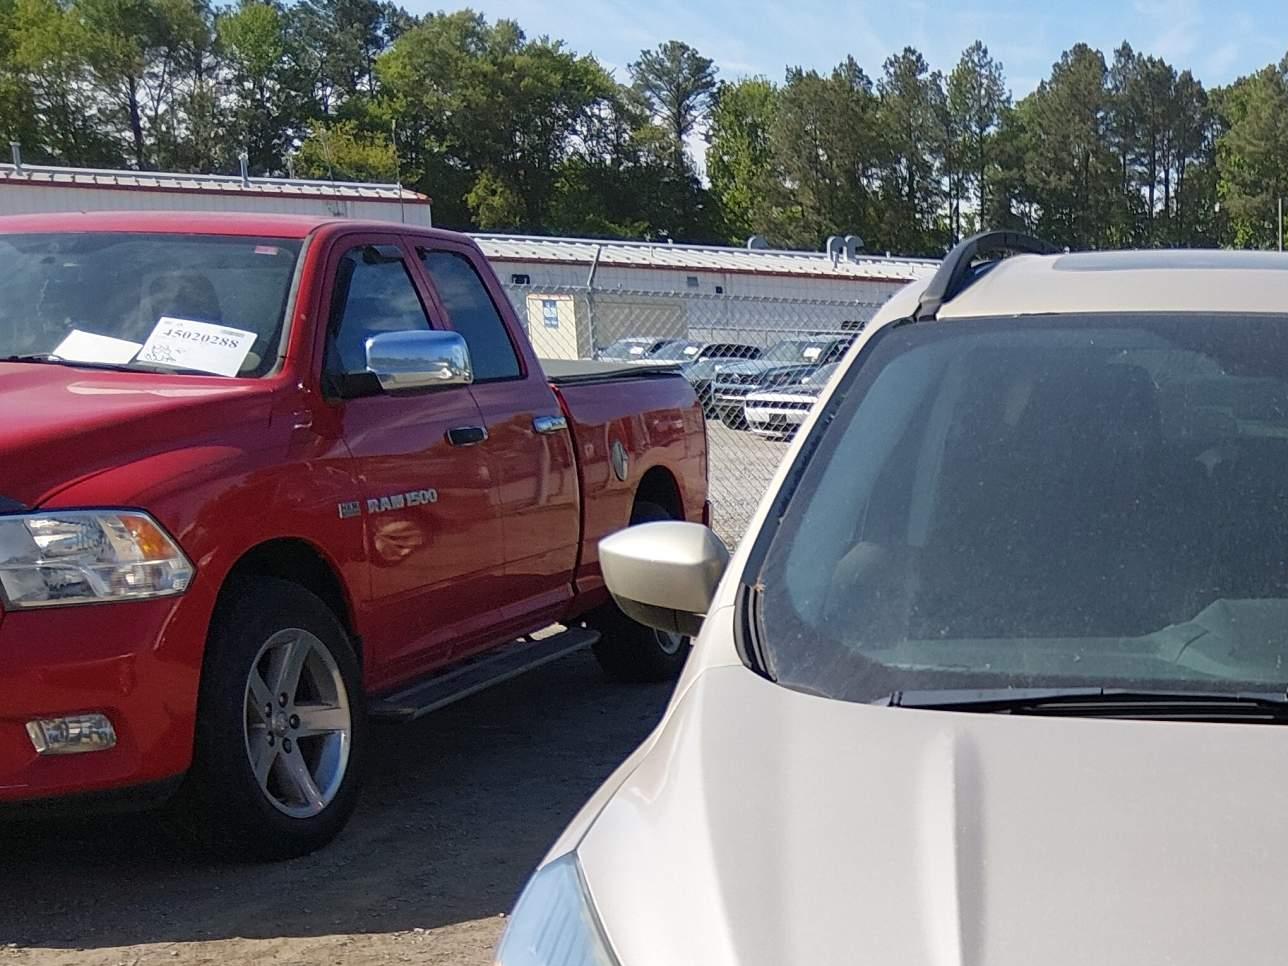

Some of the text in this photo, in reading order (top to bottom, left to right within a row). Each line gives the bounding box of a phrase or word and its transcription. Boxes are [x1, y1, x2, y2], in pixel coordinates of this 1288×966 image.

[162, 328, 240, 349] 45020288
[367, 494, 404, 514] RAM
[405, 488, 438, 507] 1500
